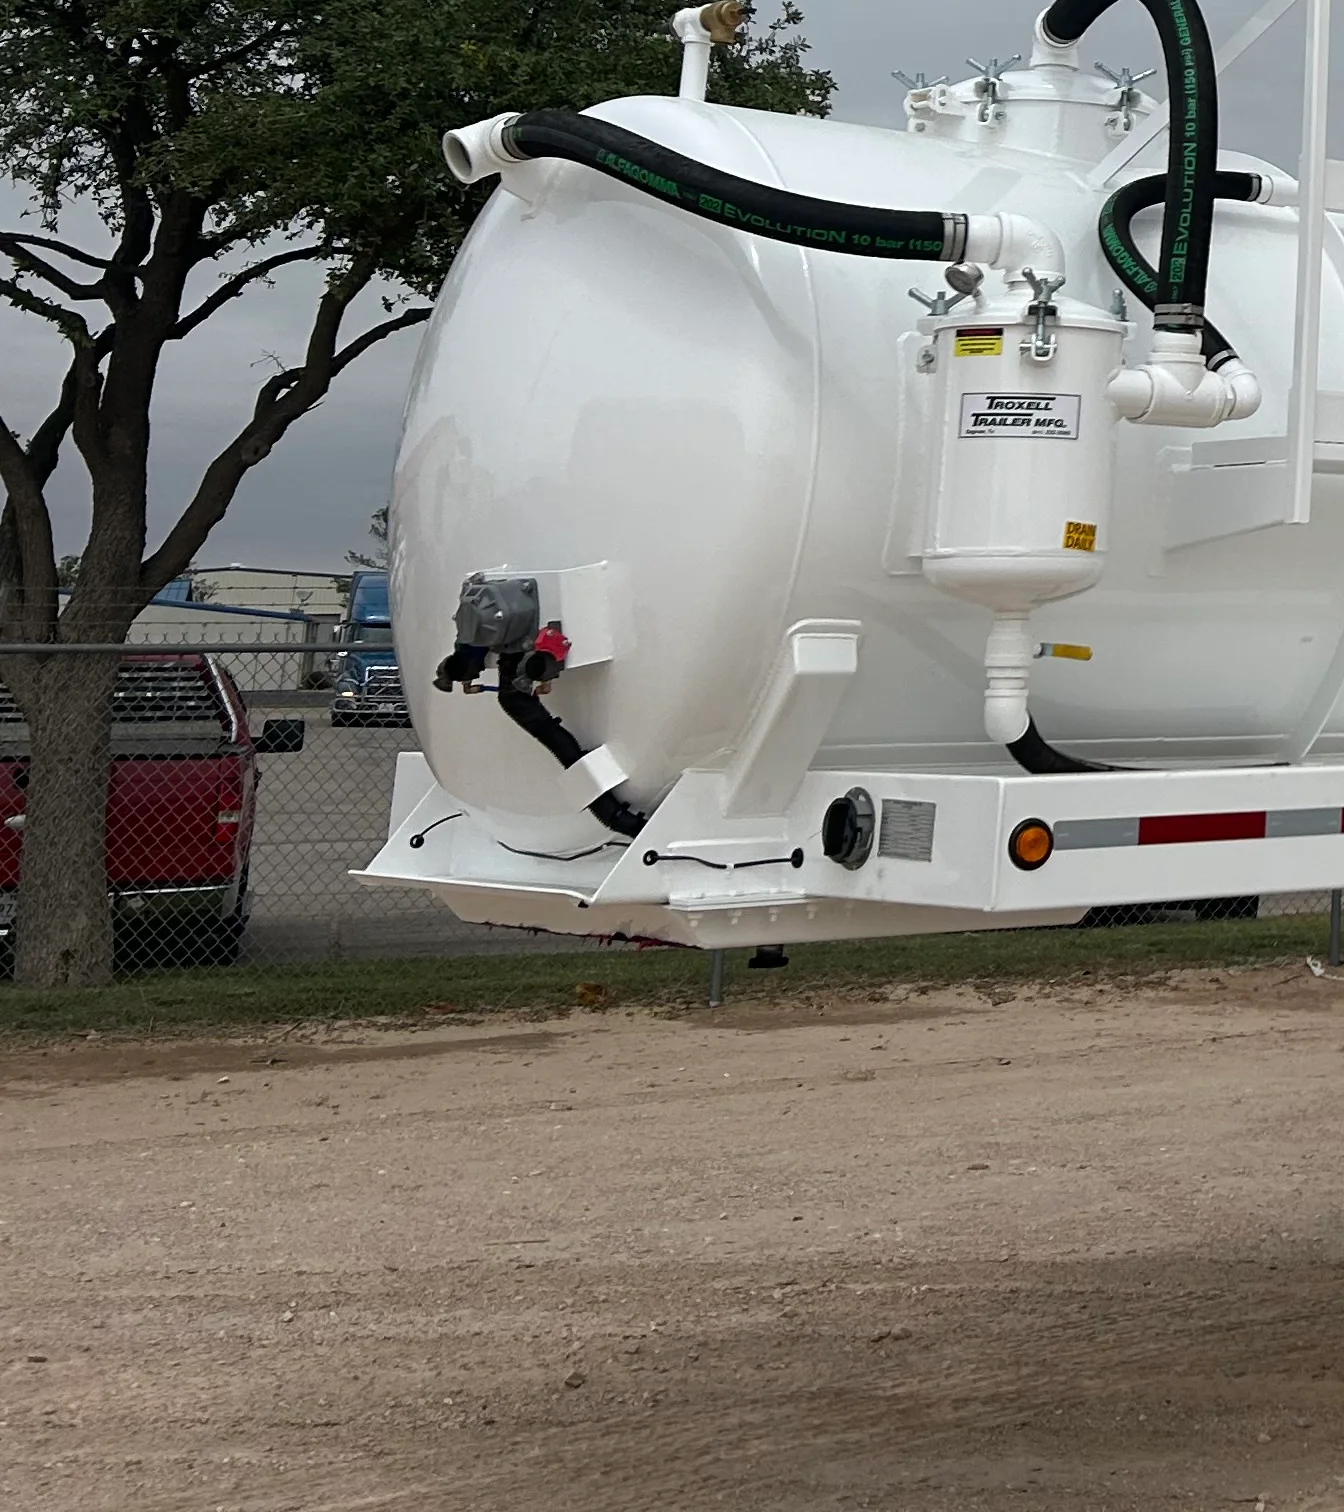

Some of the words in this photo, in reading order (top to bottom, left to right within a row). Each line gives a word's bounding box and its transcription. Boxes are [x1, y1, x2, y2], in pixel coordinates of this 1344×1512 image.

[1184, 97, 1197, 120] bar
[1184, 123, 1197, 138] 10
[1173, 142, 1197, 255] EVOLUTION
[724, 203, 847, 244] EVOLUTION
[851, 233, 871, 246] 10
[875, 236, 904, 251] bar
[986, 396, 1057, 411] TROXELL
[971, 413, 1034, 427] TRAILER
